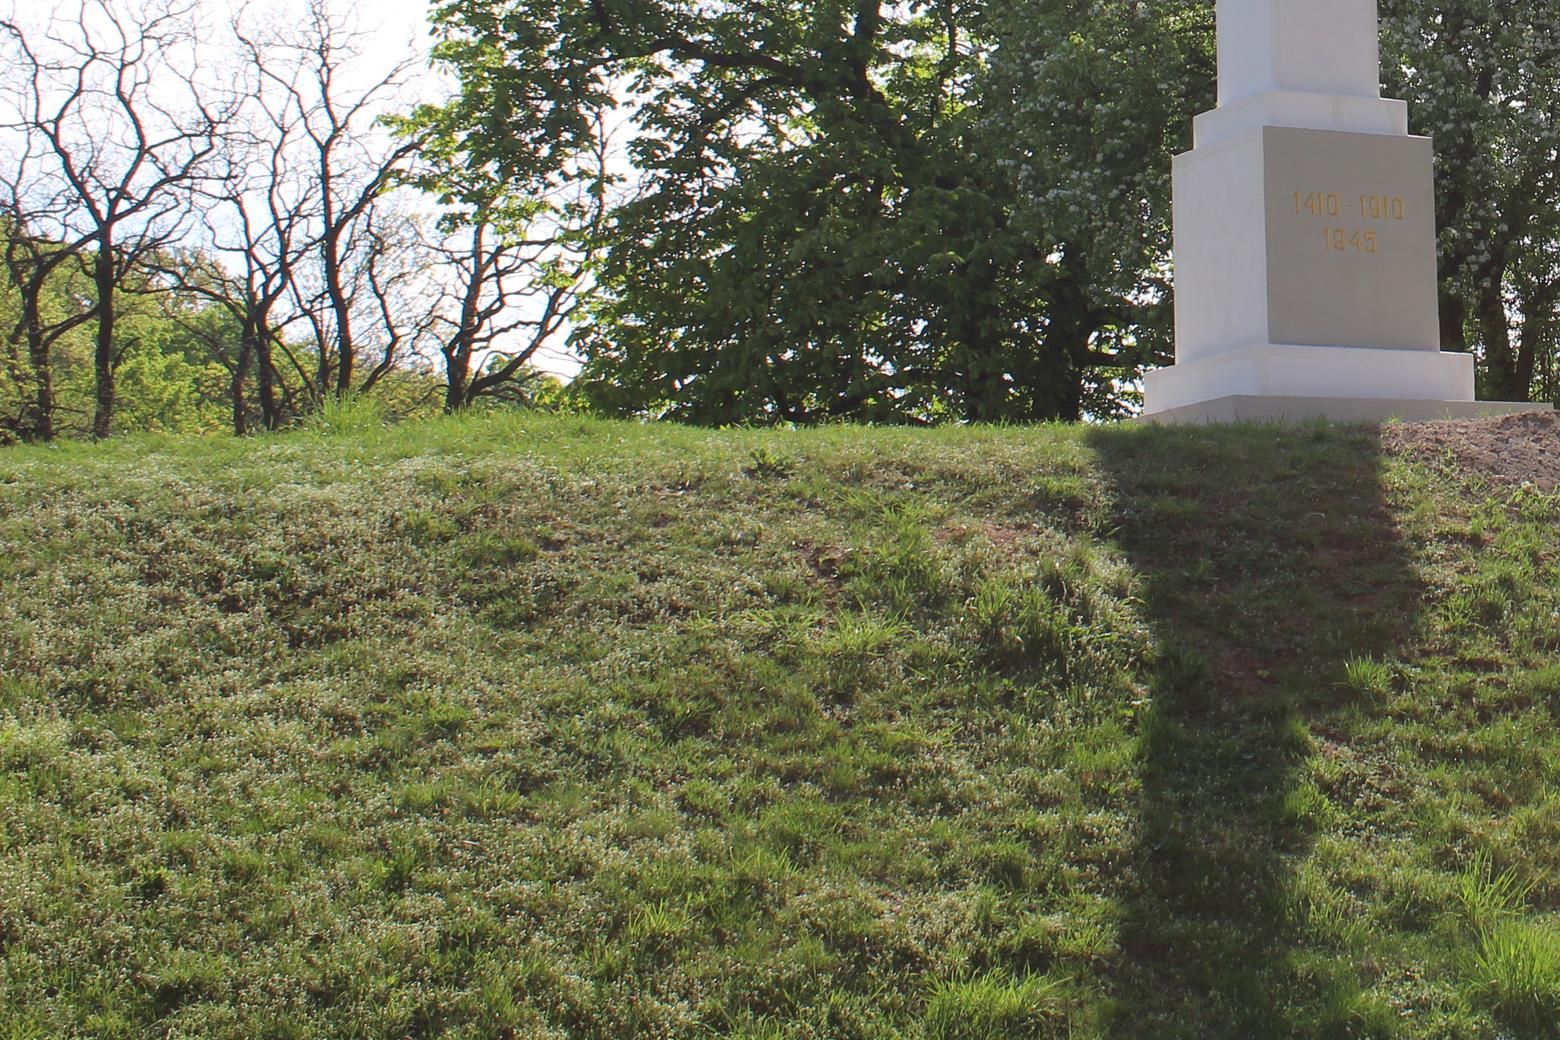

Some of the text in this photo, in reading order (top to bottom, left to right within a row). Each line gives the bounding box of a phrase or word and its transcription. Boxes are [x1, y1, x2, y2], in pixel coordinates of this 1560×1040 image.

[1294, 191, 1339, 216] 1410
[1360, 194, 1404, 220] 1910
[1324, 227, 1377, 253] 1945
